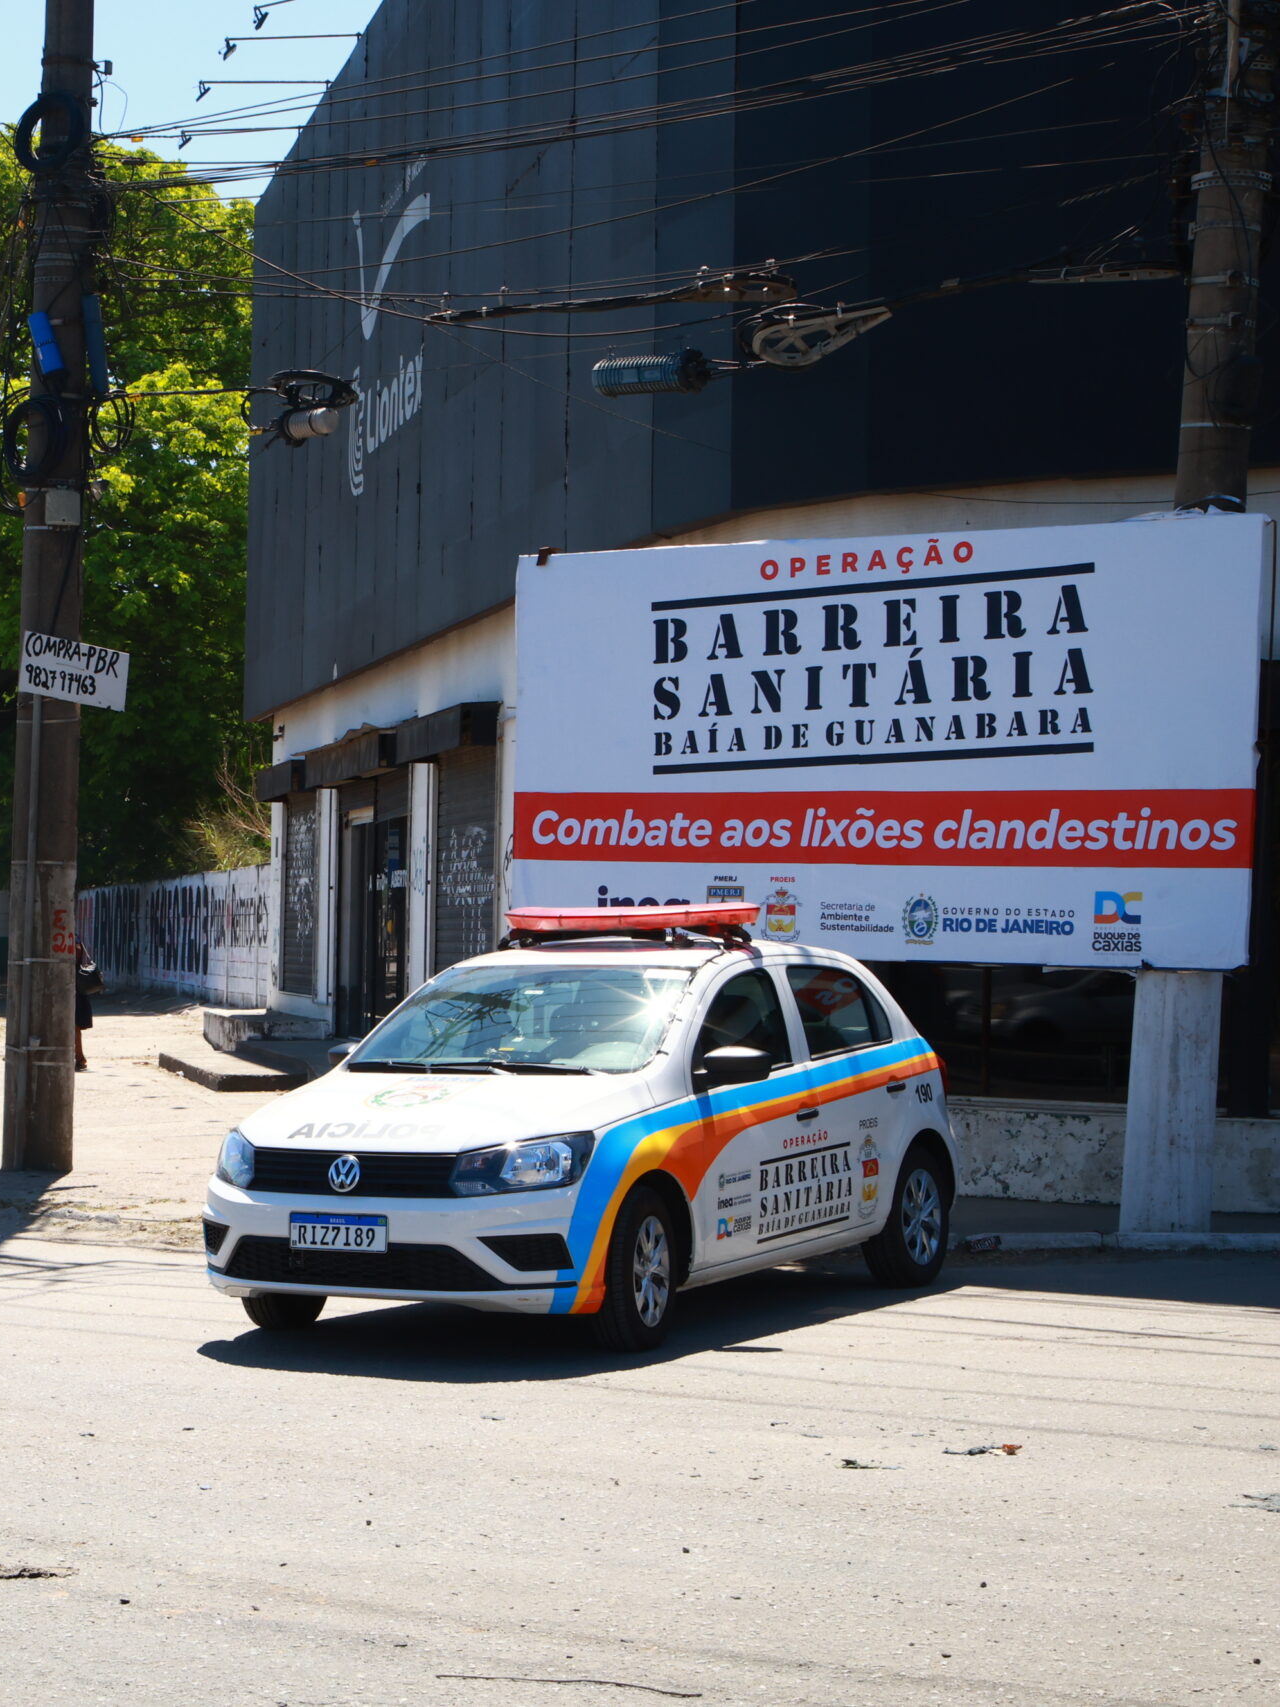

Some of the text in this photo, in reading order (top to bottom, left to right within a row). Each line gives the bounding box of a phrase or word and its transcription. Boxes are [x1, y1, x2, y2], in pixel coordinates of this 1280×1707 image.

[760, 540, 974, 580] OPERAÇÃO
[652, 584, 1089, 664] BARREIRA
[652, 646, 1094, 721] SANITÁRIA
[653, 706, 1093, 756] BAÍA DE GUANABARA
[531, 806, 1238, 852] Combate aos lixões clandestinos
[713, 875, 738, 883] PMERJ
[710, 888, 741, 897] PMERJ
[820, 902, 876, 912] Secretaria de
[820, 912, 863, 922] Ambiente
[942, 907, 1075, 918] GOVERNO DO ESTADO
[820, 922, 894, 933] Sustentabilidade
[942, 918, 1074, 935] RIO DE JANEIRO
[915, 1083, 933, 1104] 190
[858, 1117, 879, 1130] PROEIS
[783, 1129, 828, 1149] OPERAÇÃO
[760, 1150, 851, 1191] BARREIRA
[760, 1176, 853, 1218] SANITÁRIA
[758, 1215, 781, 1235] BAÍA
[798, 1201, 851, 1223] GUANABARA
